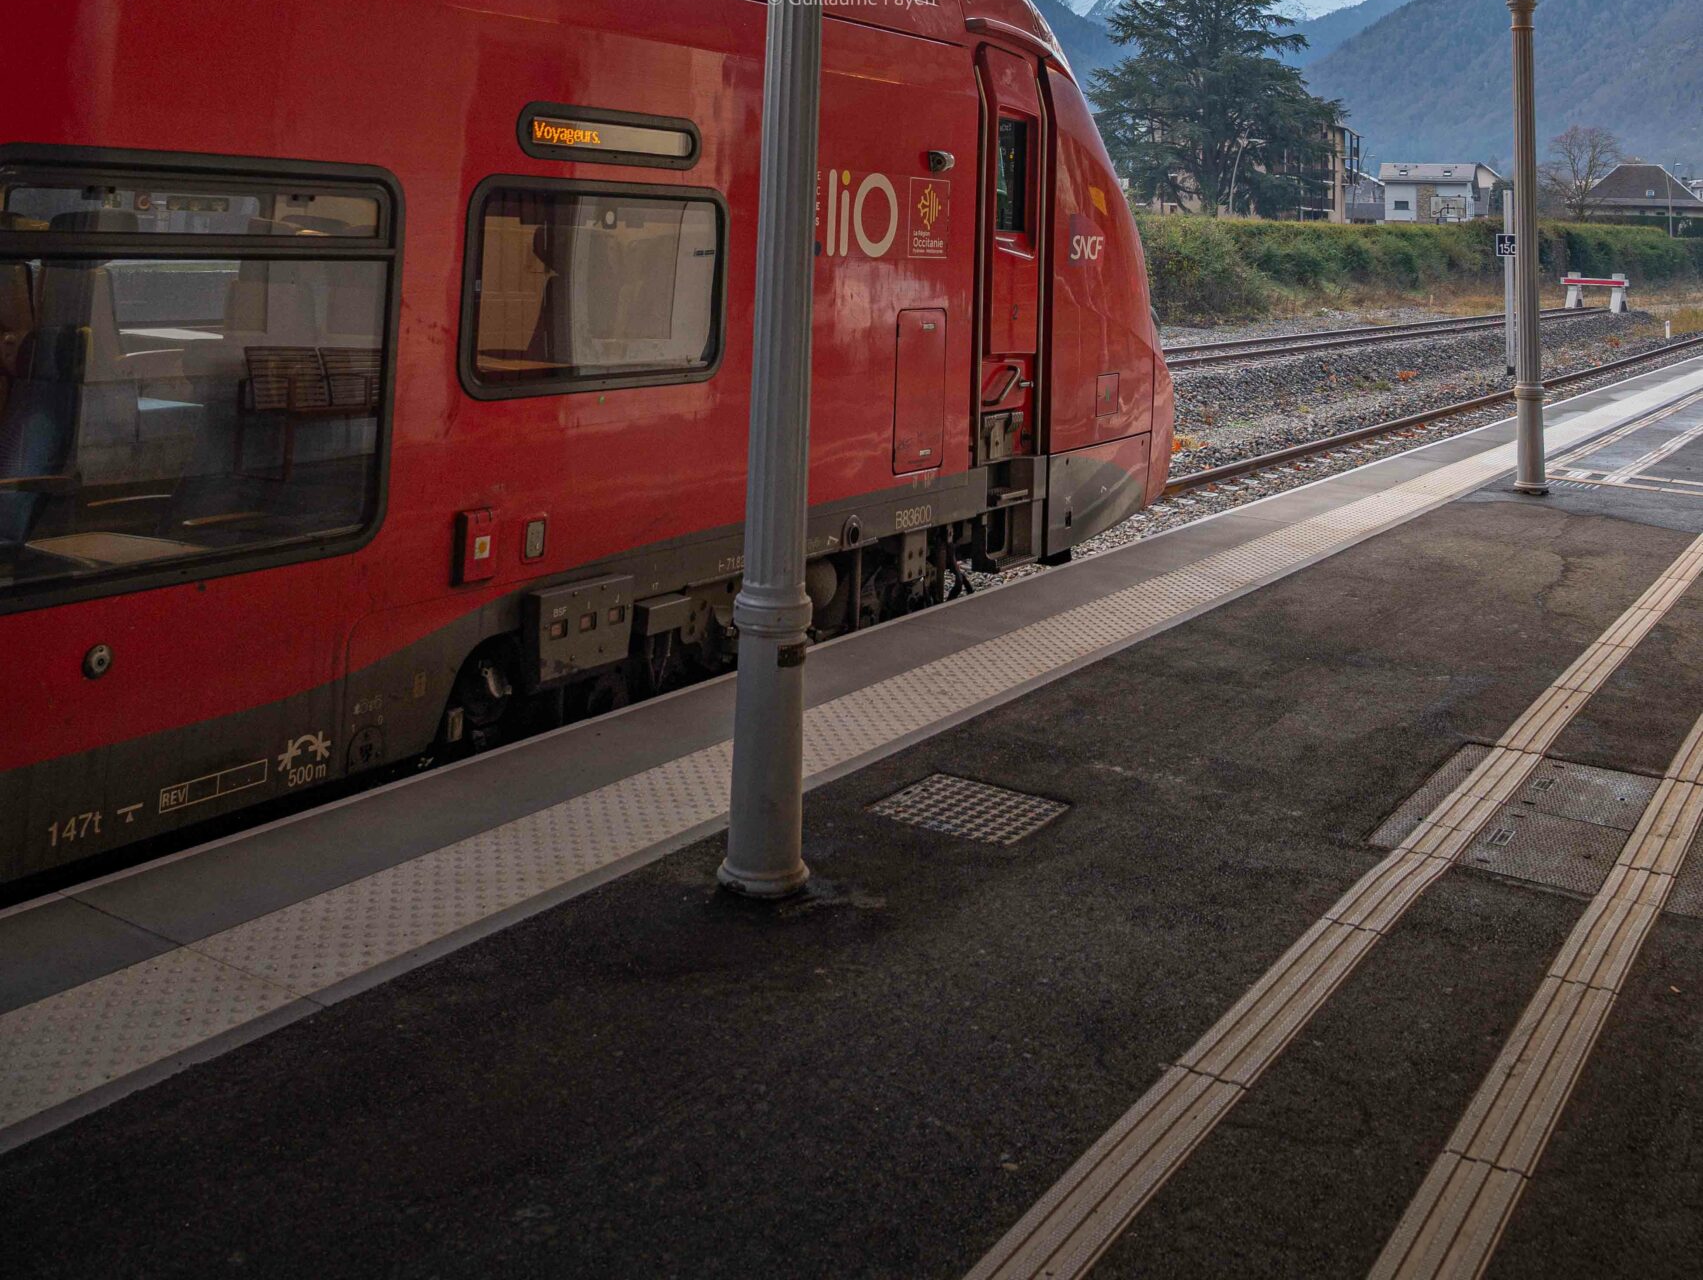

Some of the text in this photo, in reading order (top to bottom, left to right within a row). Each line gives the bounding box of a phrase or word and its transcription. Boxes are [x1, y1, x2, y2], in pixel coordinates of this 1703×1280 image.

[534, 121, 601, 145] Voyageurs.
[913, 237, 944, 249] Occitanie
[1070, 234, 1104, 260] SNCF
[1505, 235, 1511, 244] L
[1012, 303, 1019, 320] 2
[553, 606, 567, 618] BSF
[288, 763, 327, 788] 500 m
[161, 788, 187, 808] REV
[48, 810, 103, 847] 147t
